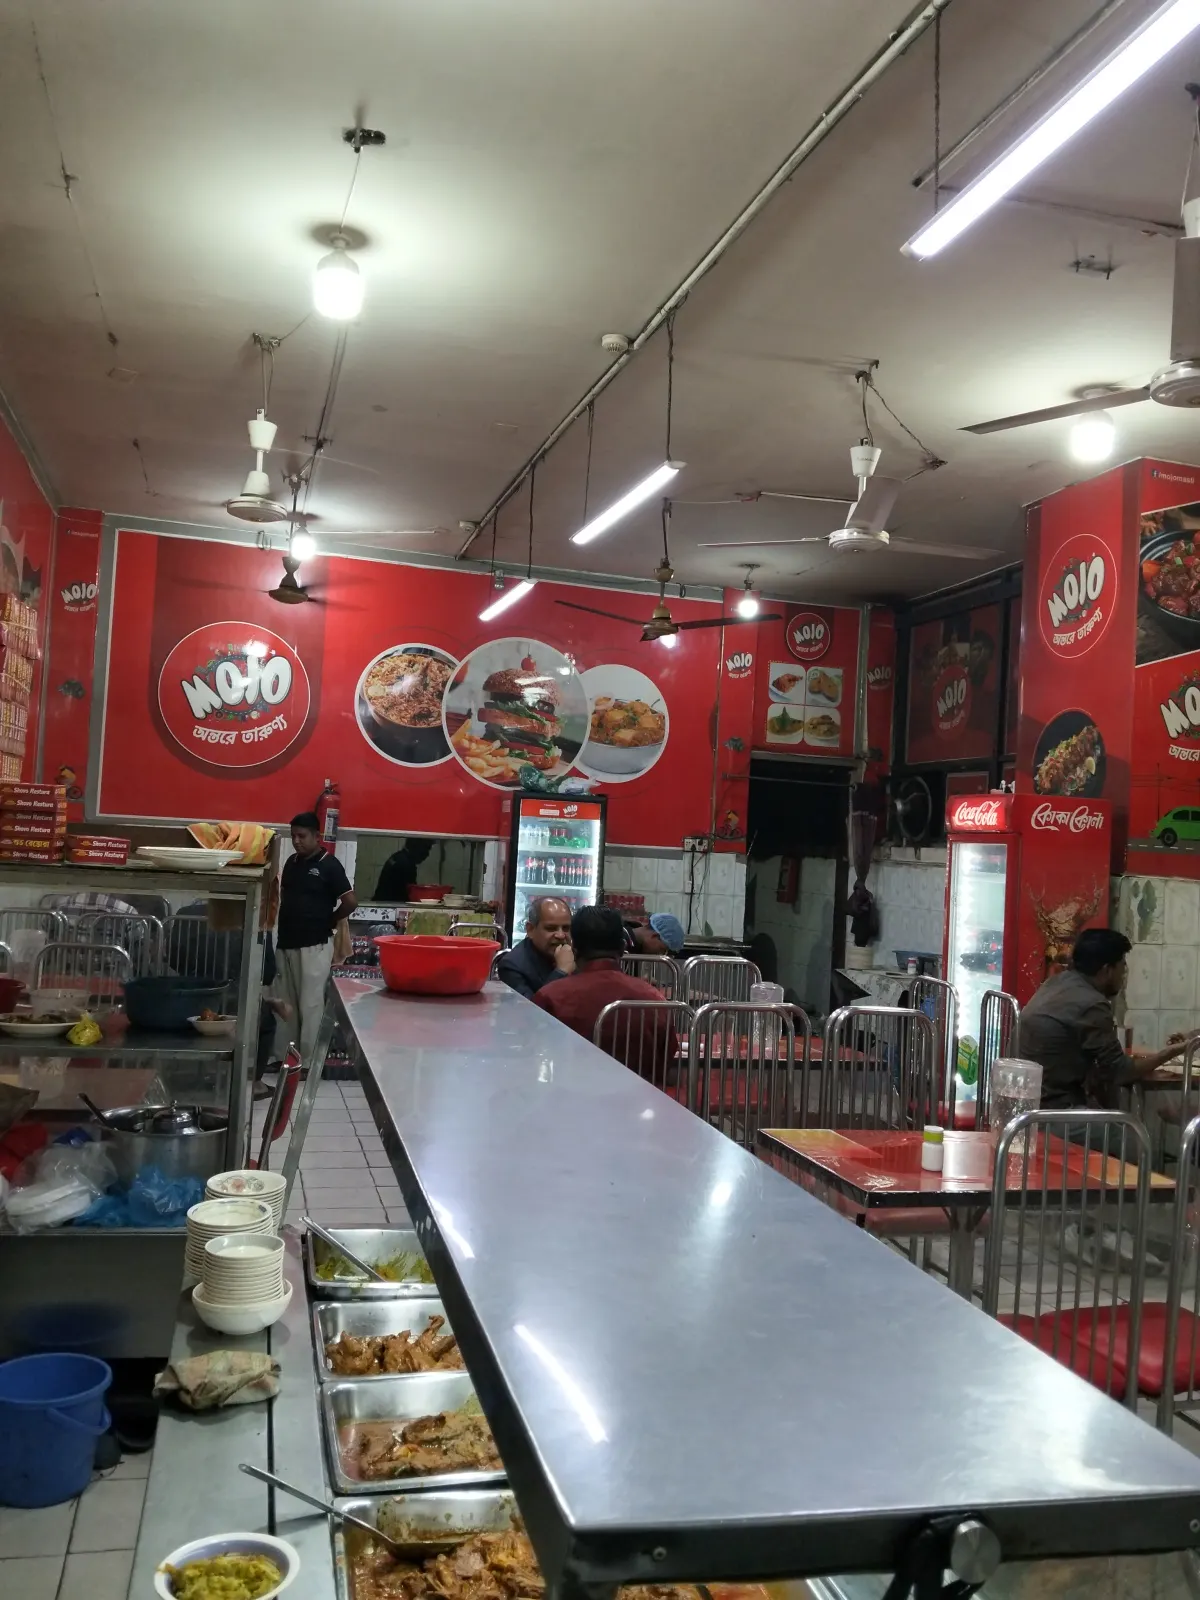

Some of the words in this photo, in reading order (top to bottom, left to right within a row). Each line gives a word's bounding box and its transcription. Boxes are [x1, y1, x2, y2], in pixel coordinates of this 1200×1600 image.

[61, 582, 97, 604] MOJO
[1047, 556, 1105, 629] MOJO
[793, 623, 825, 644] MOJO
[725, 652, 753, 671] MOJO
[866, 666, 892, 684] MOJO
[181, 655, 292, 720] MOJO
[936, 678, 967, 717] MOJO
[192, 725, 238, 745] অন্তরে
[241, 713, 288, 744] তারুণ্য
